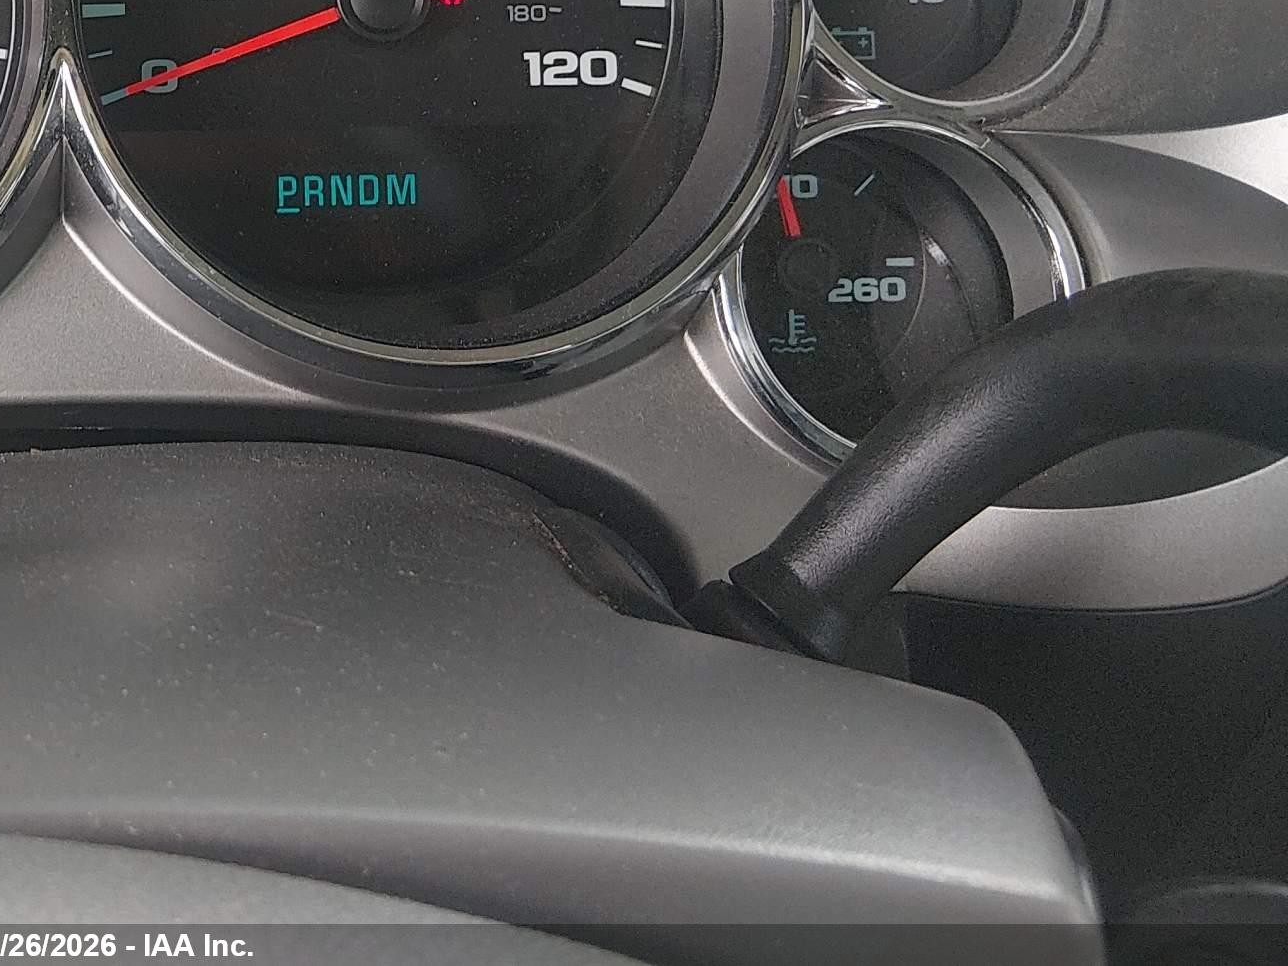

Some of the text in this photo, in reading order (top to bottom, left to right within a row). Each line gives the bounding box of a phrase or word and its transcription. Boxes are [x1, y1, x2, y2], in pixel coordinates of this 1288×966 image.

[507, 4, 546, 22] 180
[142, 58, 178, 94] 0
[524, 51, 618, 86] 120
[277, 174, 416, 211] PRNDM
[828, 278, 906, 302] 260
